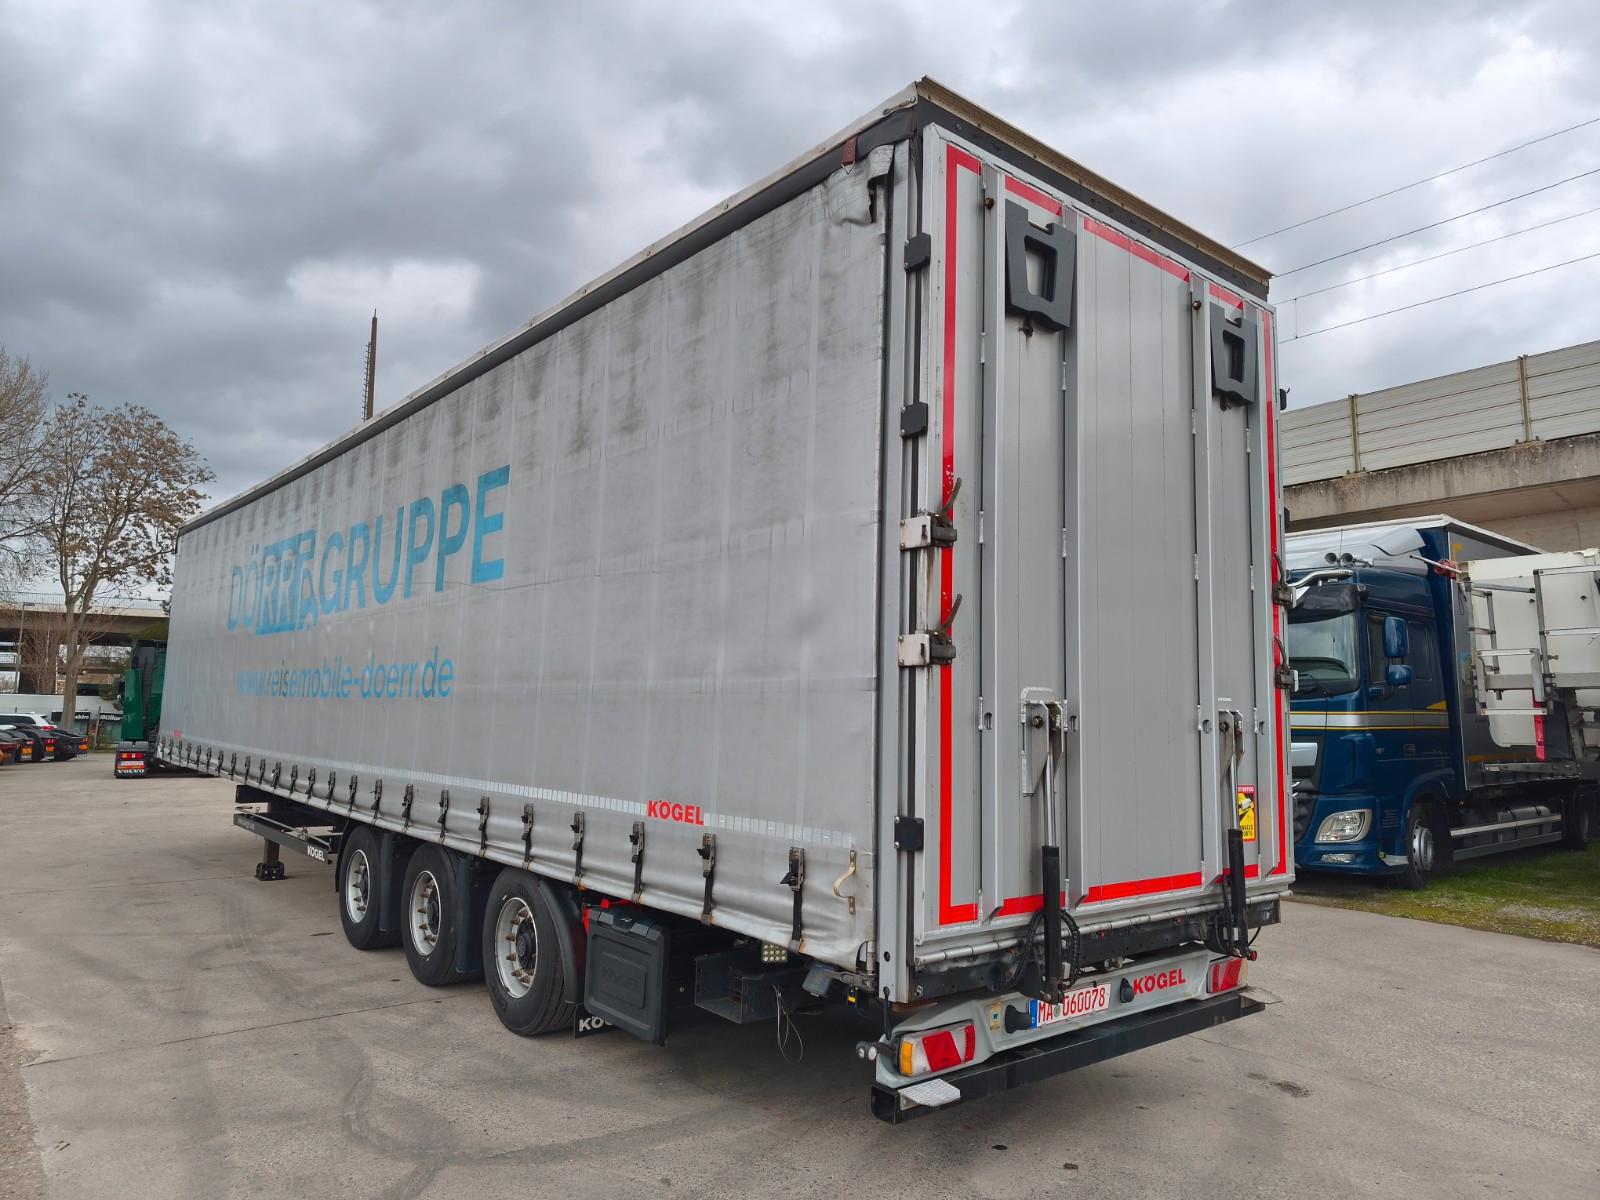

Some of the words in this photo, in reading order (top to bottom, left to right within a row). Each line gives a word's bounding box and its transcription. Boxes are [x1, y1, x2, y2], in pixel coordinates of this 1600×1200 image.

[318, 464, 510, 616] GRUPPE
[237, 646, 453, 699] www.reisemobile-doerr.de
[647, 799, 704, 826] KÖGEL
[1133, 969, 1185, 995] KÖGEL
[1038, 1001, 1053, 1024] MA
[1062, 987, 1106, 1017] 060078
